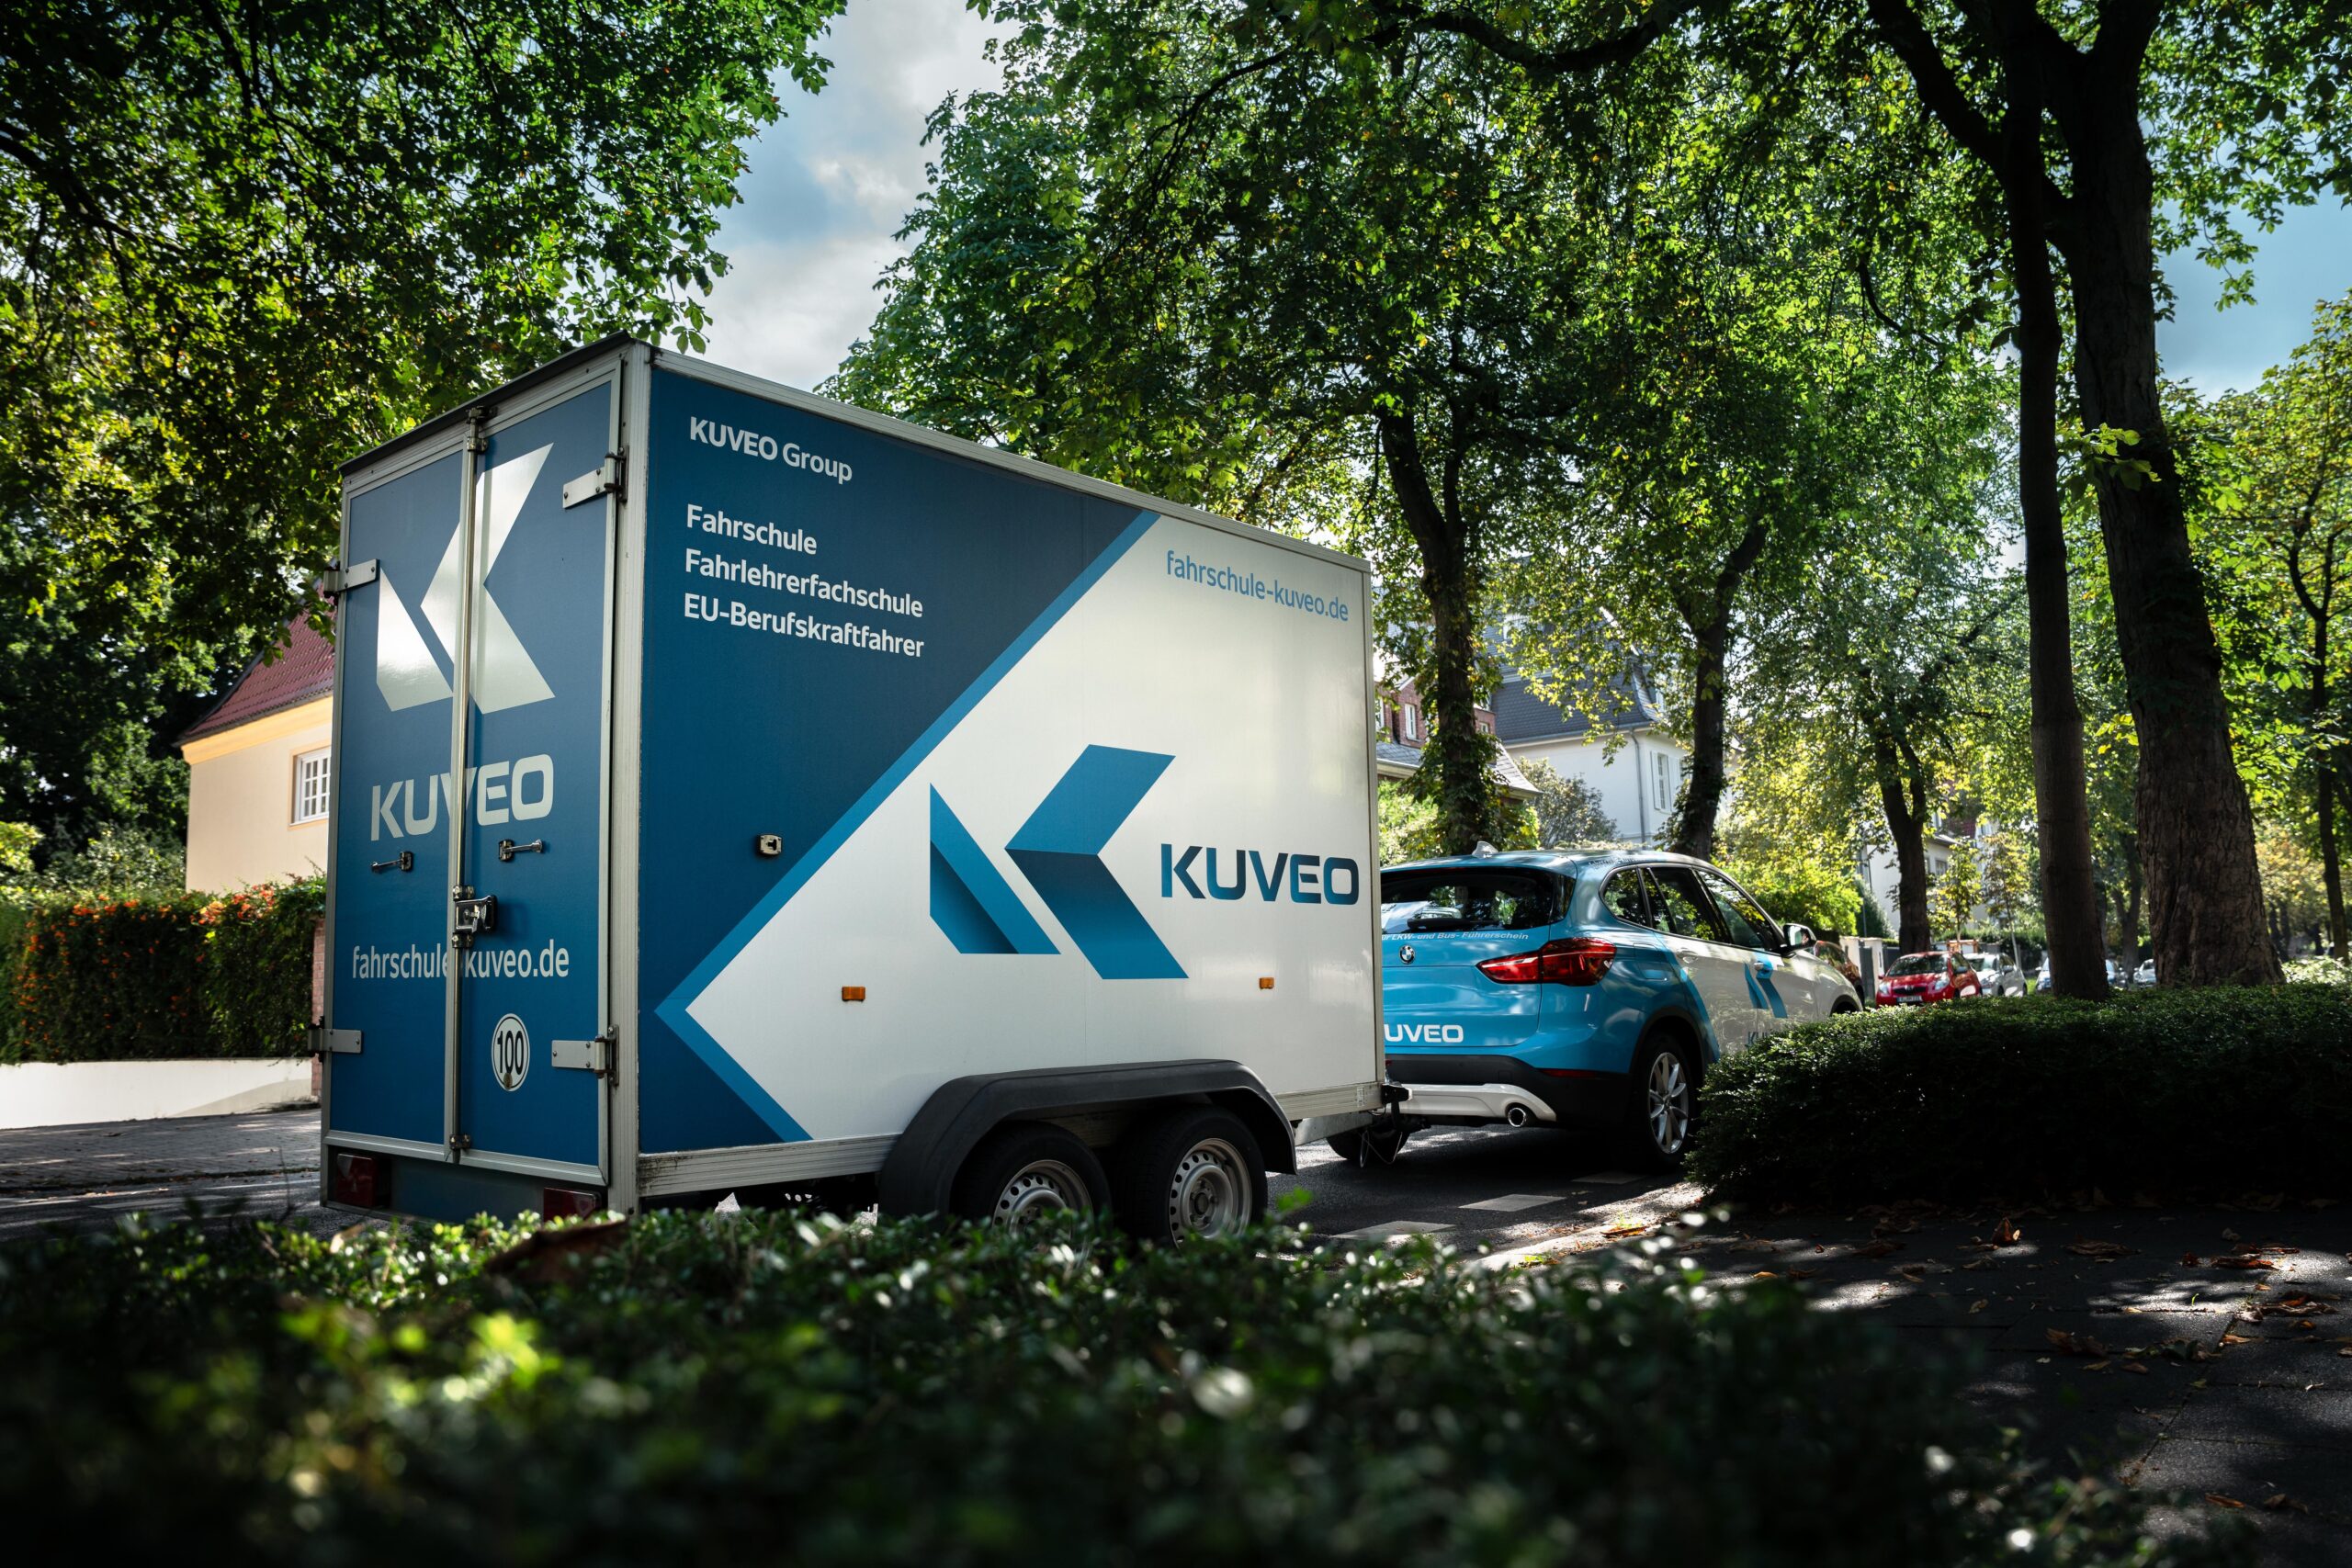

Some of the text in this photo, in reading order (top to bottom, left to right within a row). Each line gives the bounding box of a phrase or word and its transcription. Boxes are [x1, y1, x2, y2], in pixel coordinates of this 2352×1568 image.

[690, 416, 853, 485] KUVEO Group
[686, 503, 817, 555] Fahrschule
[685, 547, 923, 618] Fahrlehrerfachschule
[1167, 550, 1349, 621] fahrschule-kuveo.de
[684, 592, 924, 658] EU-Berufskraftfahrer
[371, 753, 554, 840] KUVEO
[1160, 843, 1360, 906] KUVEO
[1462, 931, 1529, 940] Führerschein
[497, 1030, 525, 1075] 100
[1384, 1024, 1464, 1043] UVEO
